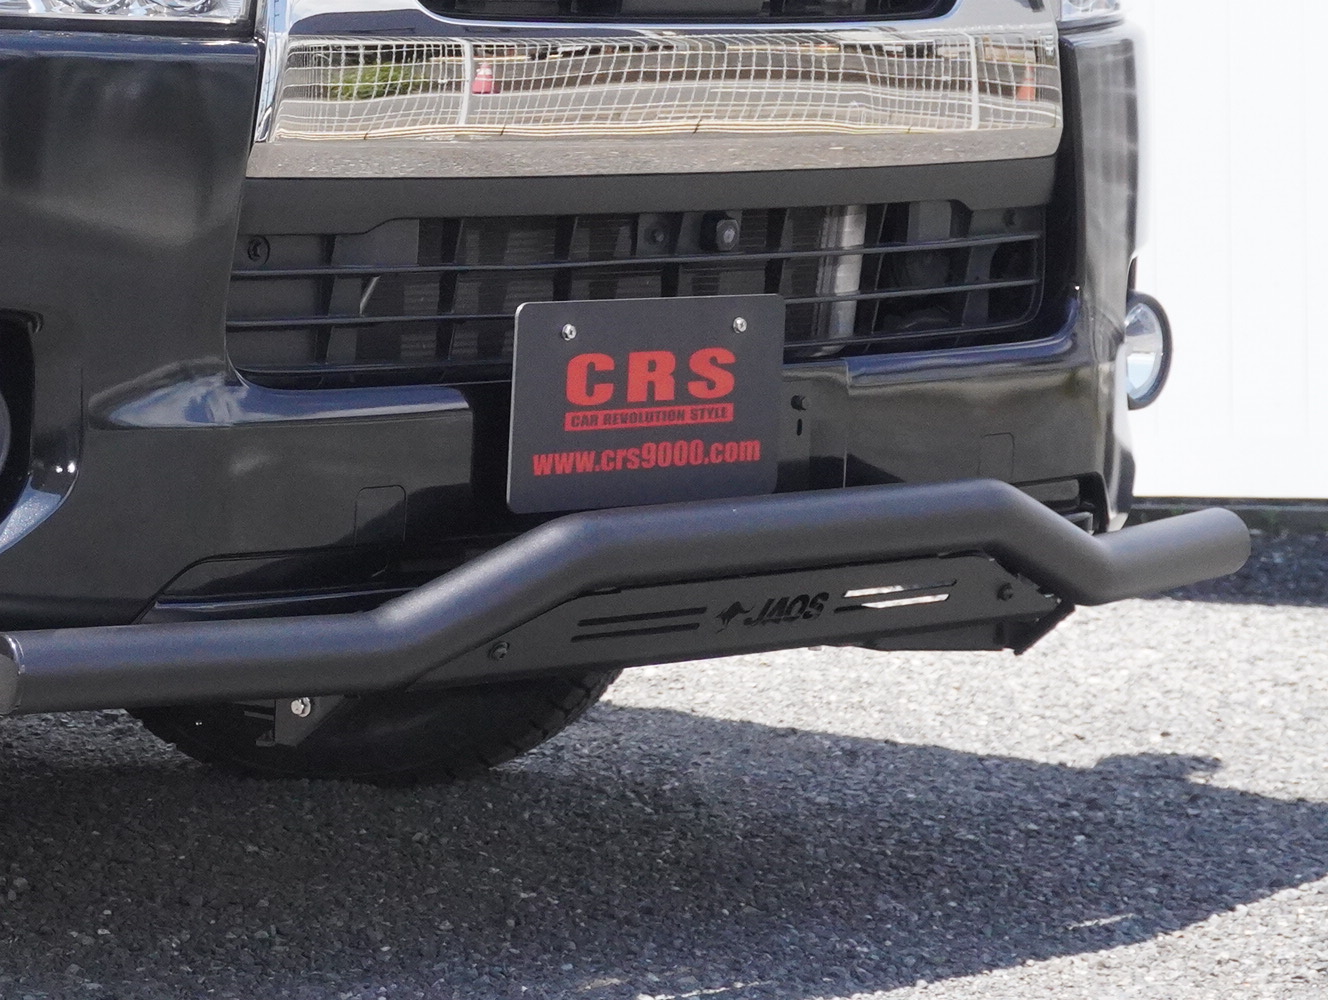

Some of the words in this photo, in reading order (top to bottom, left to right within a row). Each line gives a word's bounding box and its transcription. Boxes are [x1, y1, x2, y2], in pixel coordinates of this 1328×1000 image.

[565, 347, 737, 406] CRS
[572, 413, 599, 427] CAR
[603, 409, 686, 425] REVOLUTION
[690, 406, 728, 421] STYLE
[532, 439, 761, 476] www.crs9000.com
[743, 592, 830, 626] JAOS
